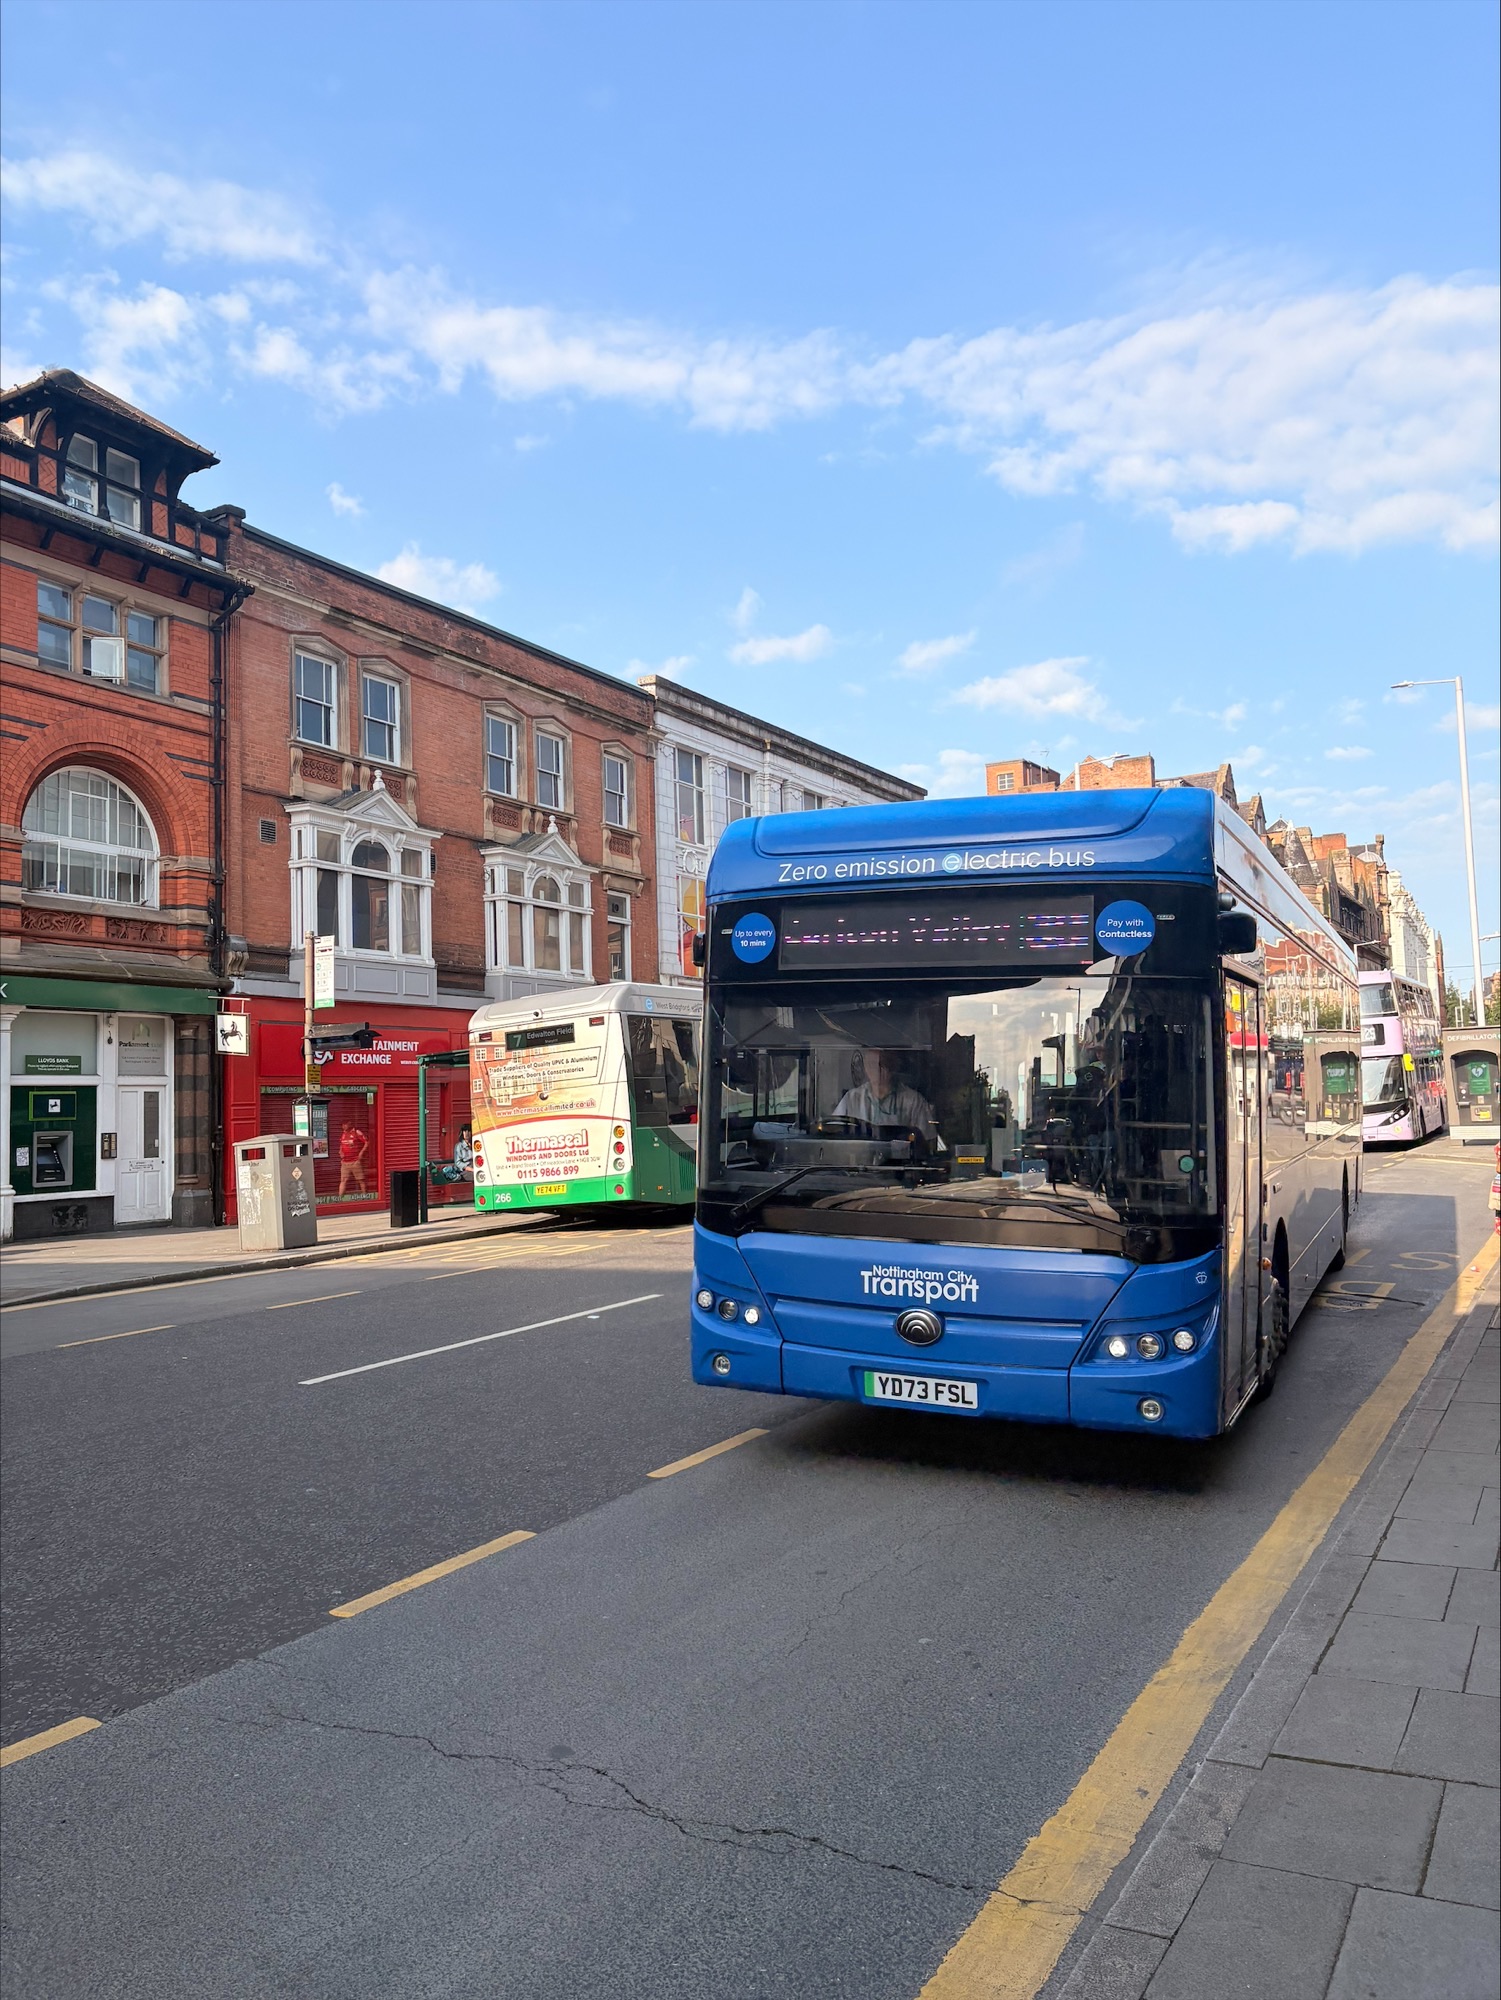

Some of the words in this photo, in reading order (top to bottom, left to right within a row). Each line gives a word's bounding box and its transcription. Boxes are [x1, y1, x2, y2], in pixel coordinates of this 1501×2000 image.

[778, 863, 827, 882] Zero
[834, 855, 935, 879] emission
[942, 849, 1041, 874] electric
[1049, 847, 1095, 868] bus
[1107, 919, 1123, 928] Pay
[1125, 919, 1144, 927] with
[754, 930, 773, 938] every
[1098, 930, 1153, 938] Contactless
[513, 1035, 522, 1047] 7
[526, 1031, 556, 1039] Edwalton
[1447, 1033, 1496, 1042] DEFIBRILLATOR
[341, 1053, 392, 1064] EXCHANGE
[503, 1064, 526, 1073] Suppliers
[534, 1061, 551, 1069] Quality
[570, 1055, 598, 1064] Aluminium
[546, 1066, 584, 1076] Conservatories
[506, 1129, 589, 1154] Thermaseal
[506, 1154, 537, 1162] WINDOWS
[554, 1150, 577, 1158] DOORS
[579, 1148, 589, 1156] Ltd
[517, 1169, 538, 1179] 0115
[540, 1167, 561, 1177] 9866
[563, 1165, 579, 1175] 899
[536, 1185, 552, 1194] YE74
[495, 1193, 512, 1203] 266
[873, 1265, 944, 1282] Nottingham
[947, 1270, 972, 1285] City
[860, 1271, 979, 1304] Transport
[878, 1376, 929, 1400] YD73
[935, 1382, 973, 1405] FSL
